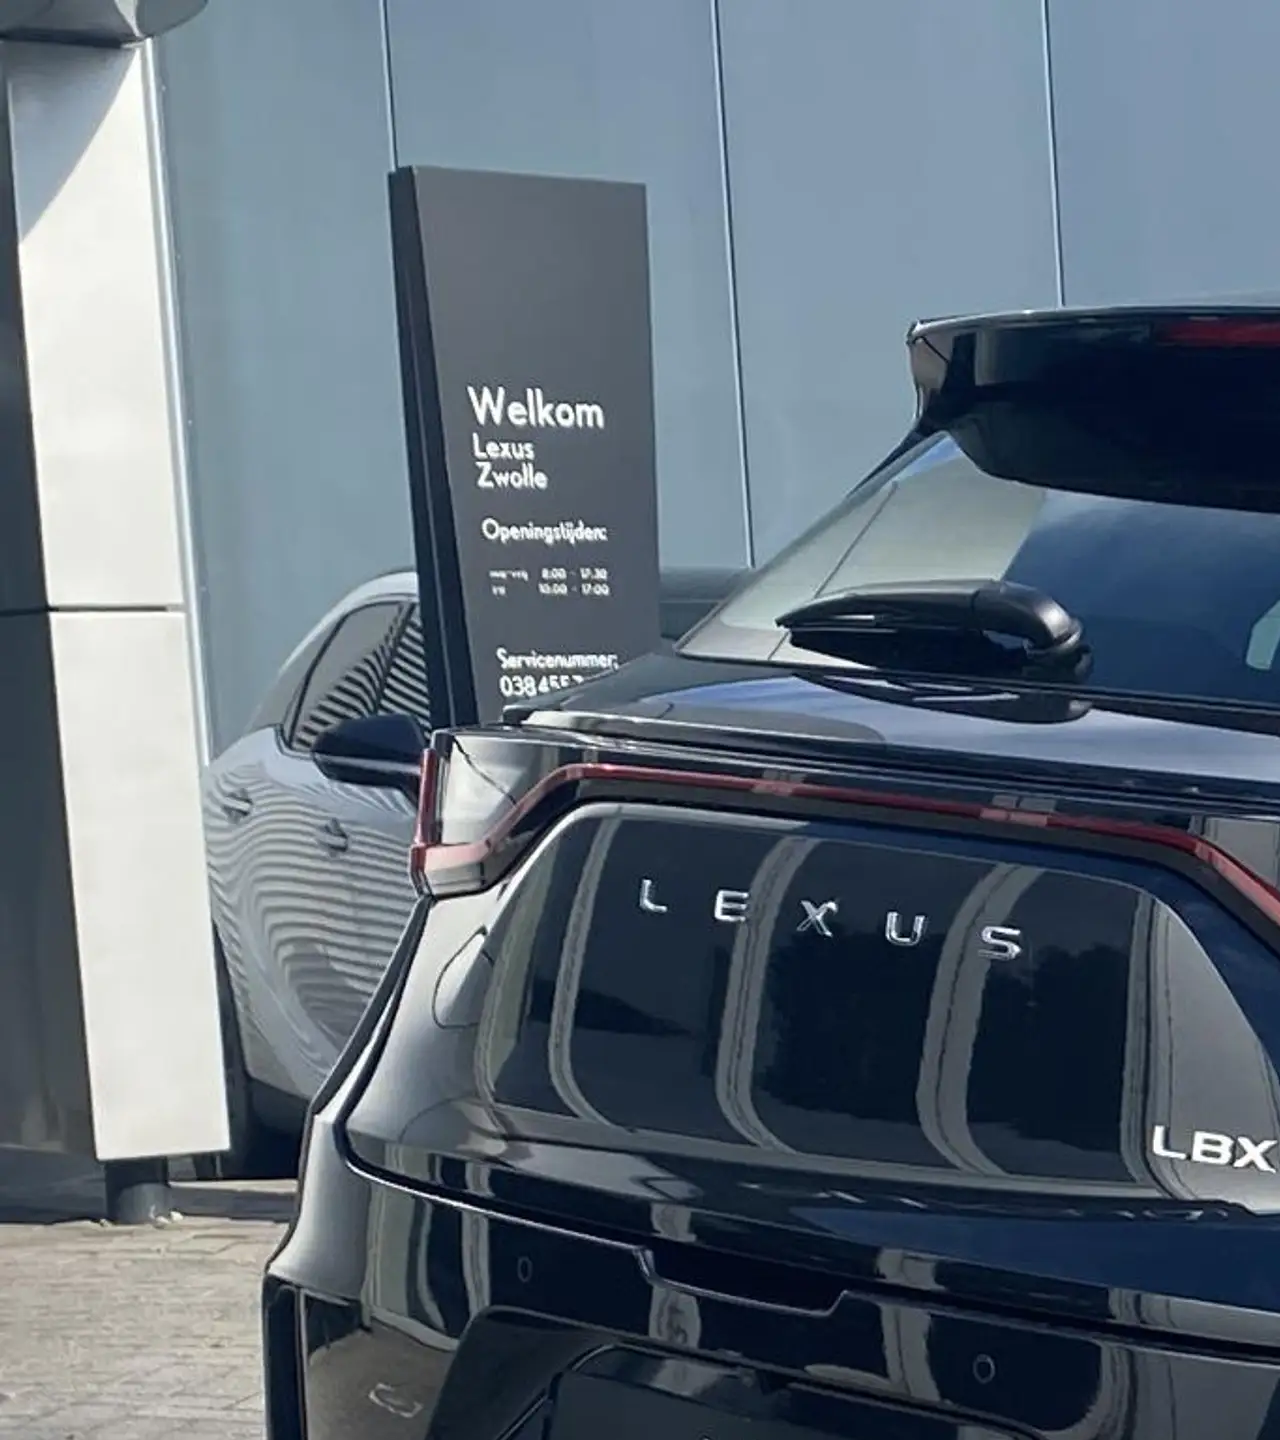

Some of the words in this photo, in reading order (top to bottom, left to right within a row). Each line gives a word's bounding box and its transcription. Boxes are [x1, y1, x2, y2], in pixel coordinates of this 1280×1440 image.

[467, 385, 605, 429] Welkom
[472, 432, 535, 461] Lexus
[475, 461, 549, 490] Zwolle
[639, 879, 1022, 961] LEXUS
[1152, 1124, 1278, 1174] LBX
